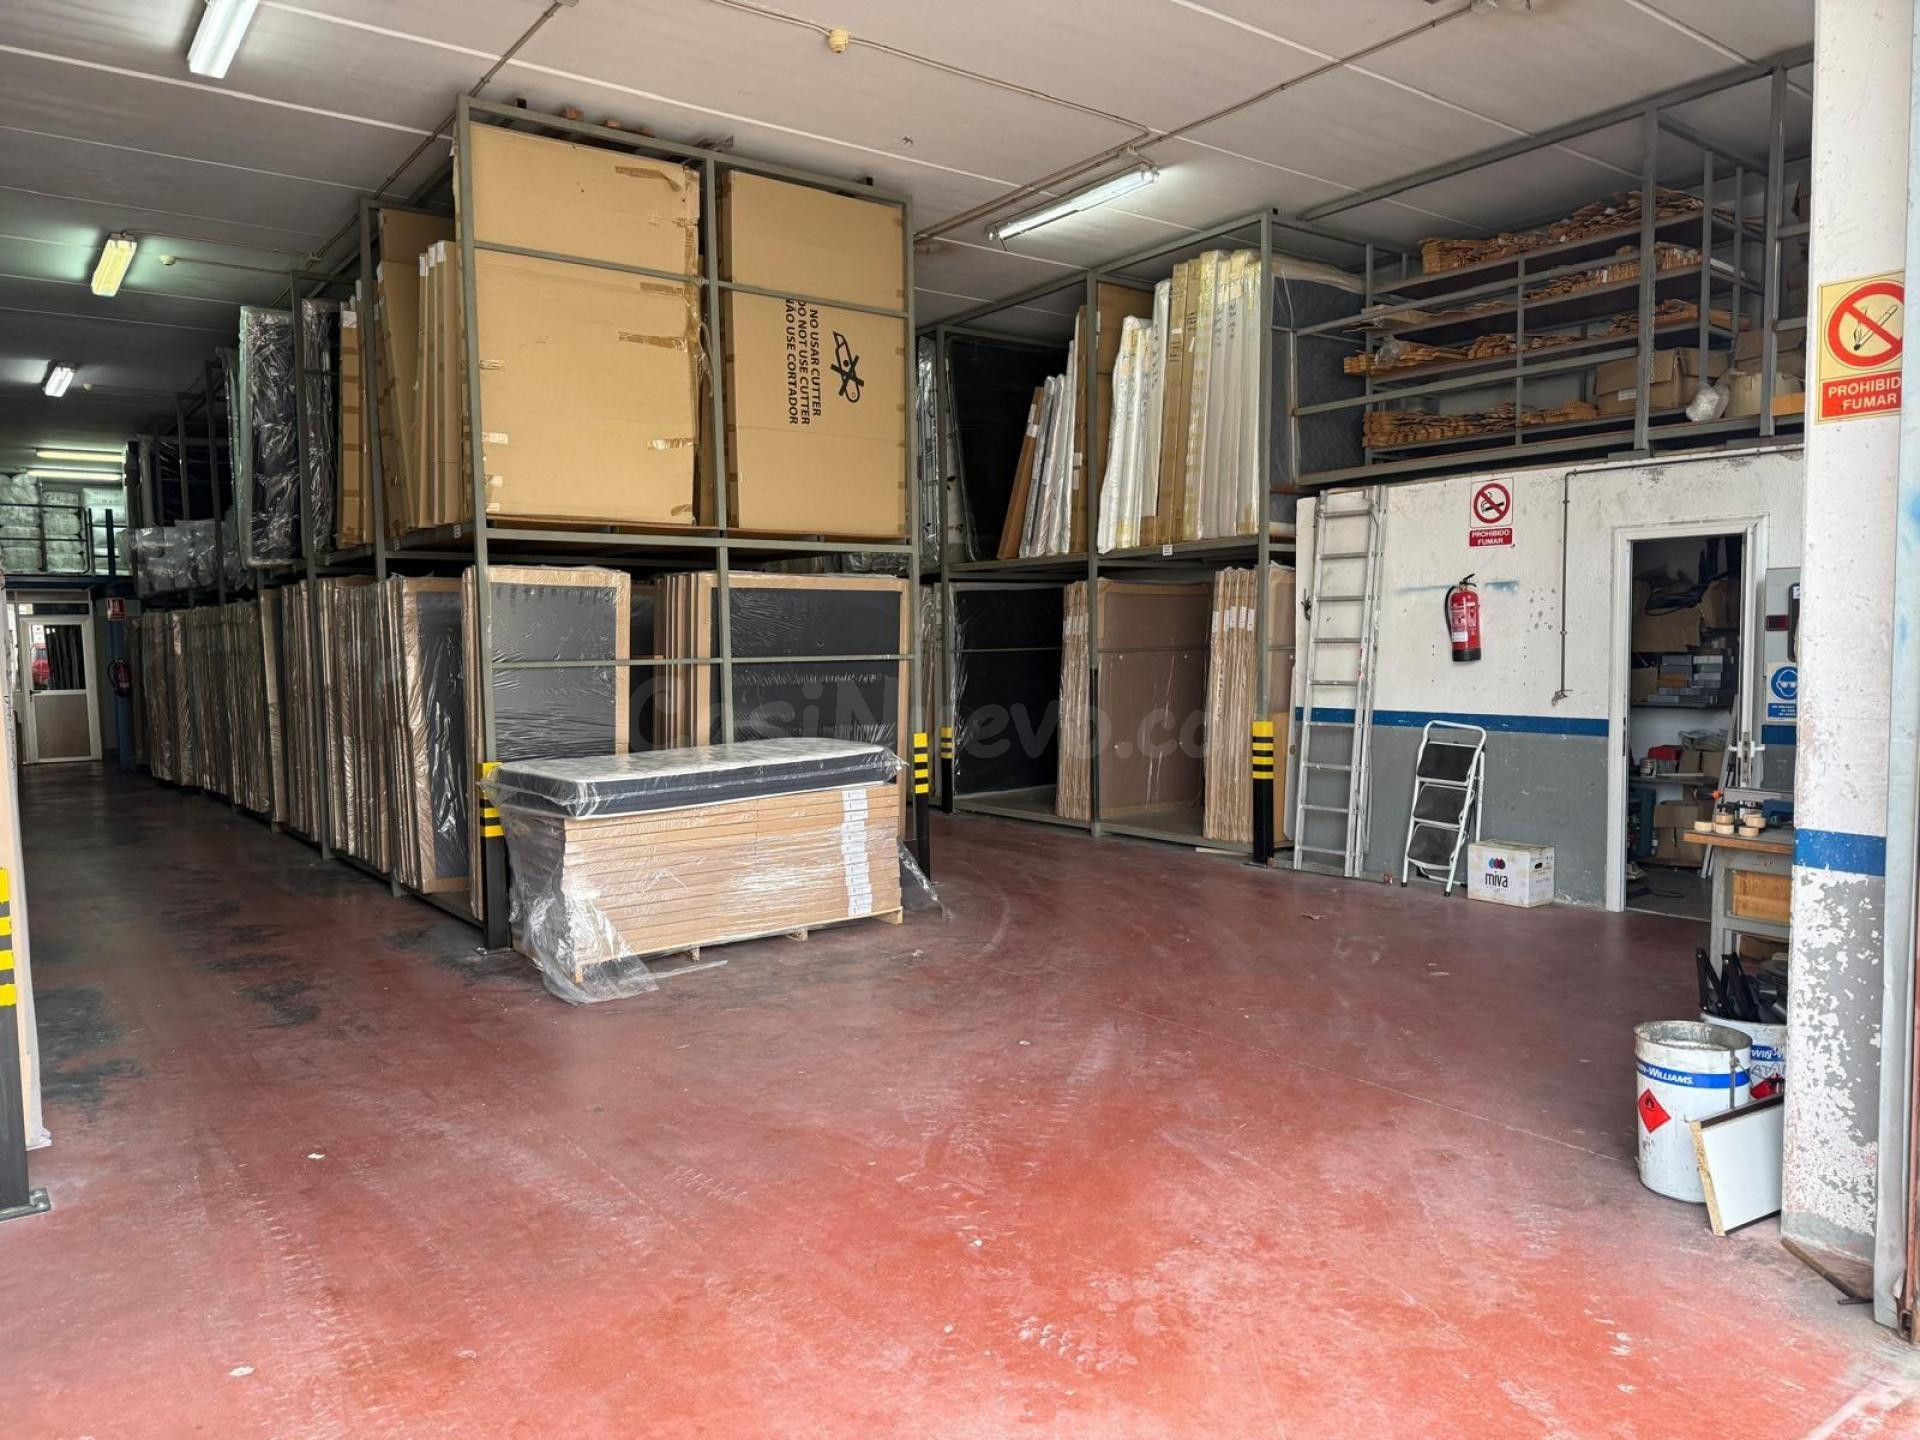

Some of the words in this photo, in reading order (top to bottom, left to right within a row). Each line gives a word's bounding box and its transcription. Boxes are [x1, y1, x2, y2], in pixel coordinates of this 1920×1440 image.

[797, 299, 807, 317] DO
[810, 309, 819, 329] NO
[786, 327, 796, 350] USE
[798, 320, 808, 347] NOT
[810, 332, 820, 366] USAR
[799, 350, 809, 373] USE
[787, 353, 799, 425] CORTADOR
[811, 368, 821, 416] CUTTER
[1828, 376, 1902, 398] PROHIBID
[800, 377, 811, 425] CUTTER
[1842, 393, 1897, 411] FUMAR
[1471, 529, 1510, 538] PROHIBIDO
[1477, 537, 1504, 545] FUMAR
[1485, 870, 1508, 888] miva
